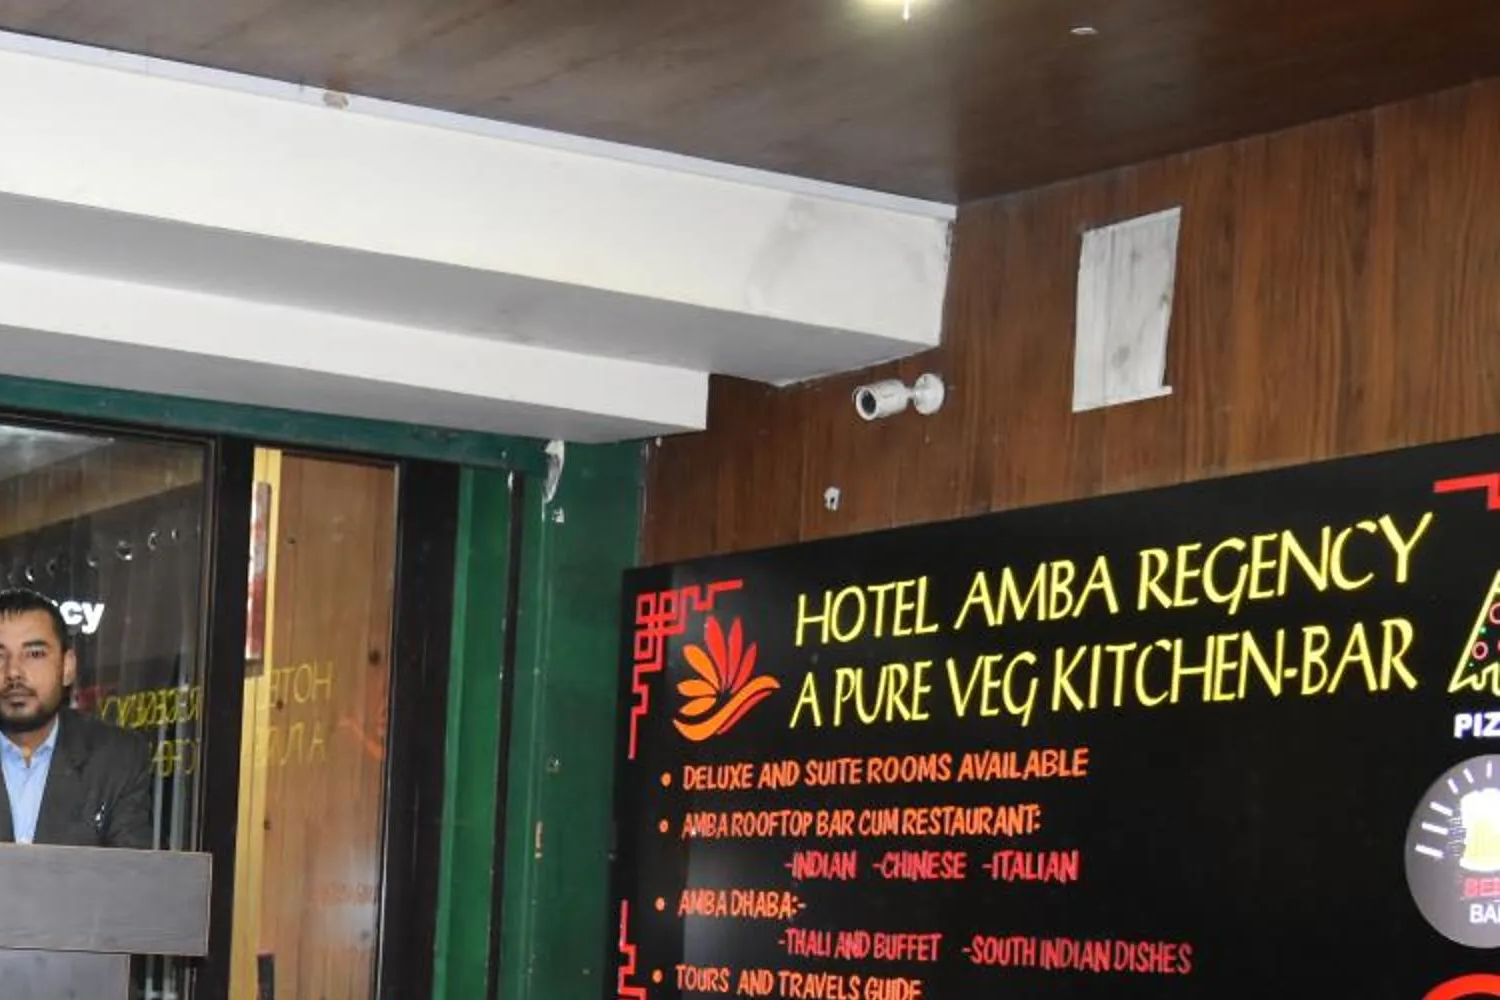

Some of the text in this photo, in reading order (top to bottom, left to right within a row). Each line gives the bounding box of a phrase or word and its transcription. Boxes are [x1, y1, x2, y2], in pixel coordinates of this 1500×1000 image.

[795, 512, 1433, 646] HOTEL AMBA REGENCY
[789, 617, 1418, 729] A PURE VEG KITCHEN-BAR
[683, 748, 1089, 790] DELUXE AND SUITE ROOMS AVAILABLE
[681, 810, 728, 840] AMBA
[730, 808, 813, 837] ROOFTOP
[815, 809, 853, 838] BAR
[858, 807, 899, 836] CUM
[677, 888, 729, 918] AMBA
[834, 926, 871, 959] AND
[873, 932, 943, 962] BUFFET
[1039, 937, 1111, 972] INDIAN
[1113, 940, 1193, 975] DISHES
[675, 963, 730, 993] TOURS
[736, 969, 773, 996] AND
